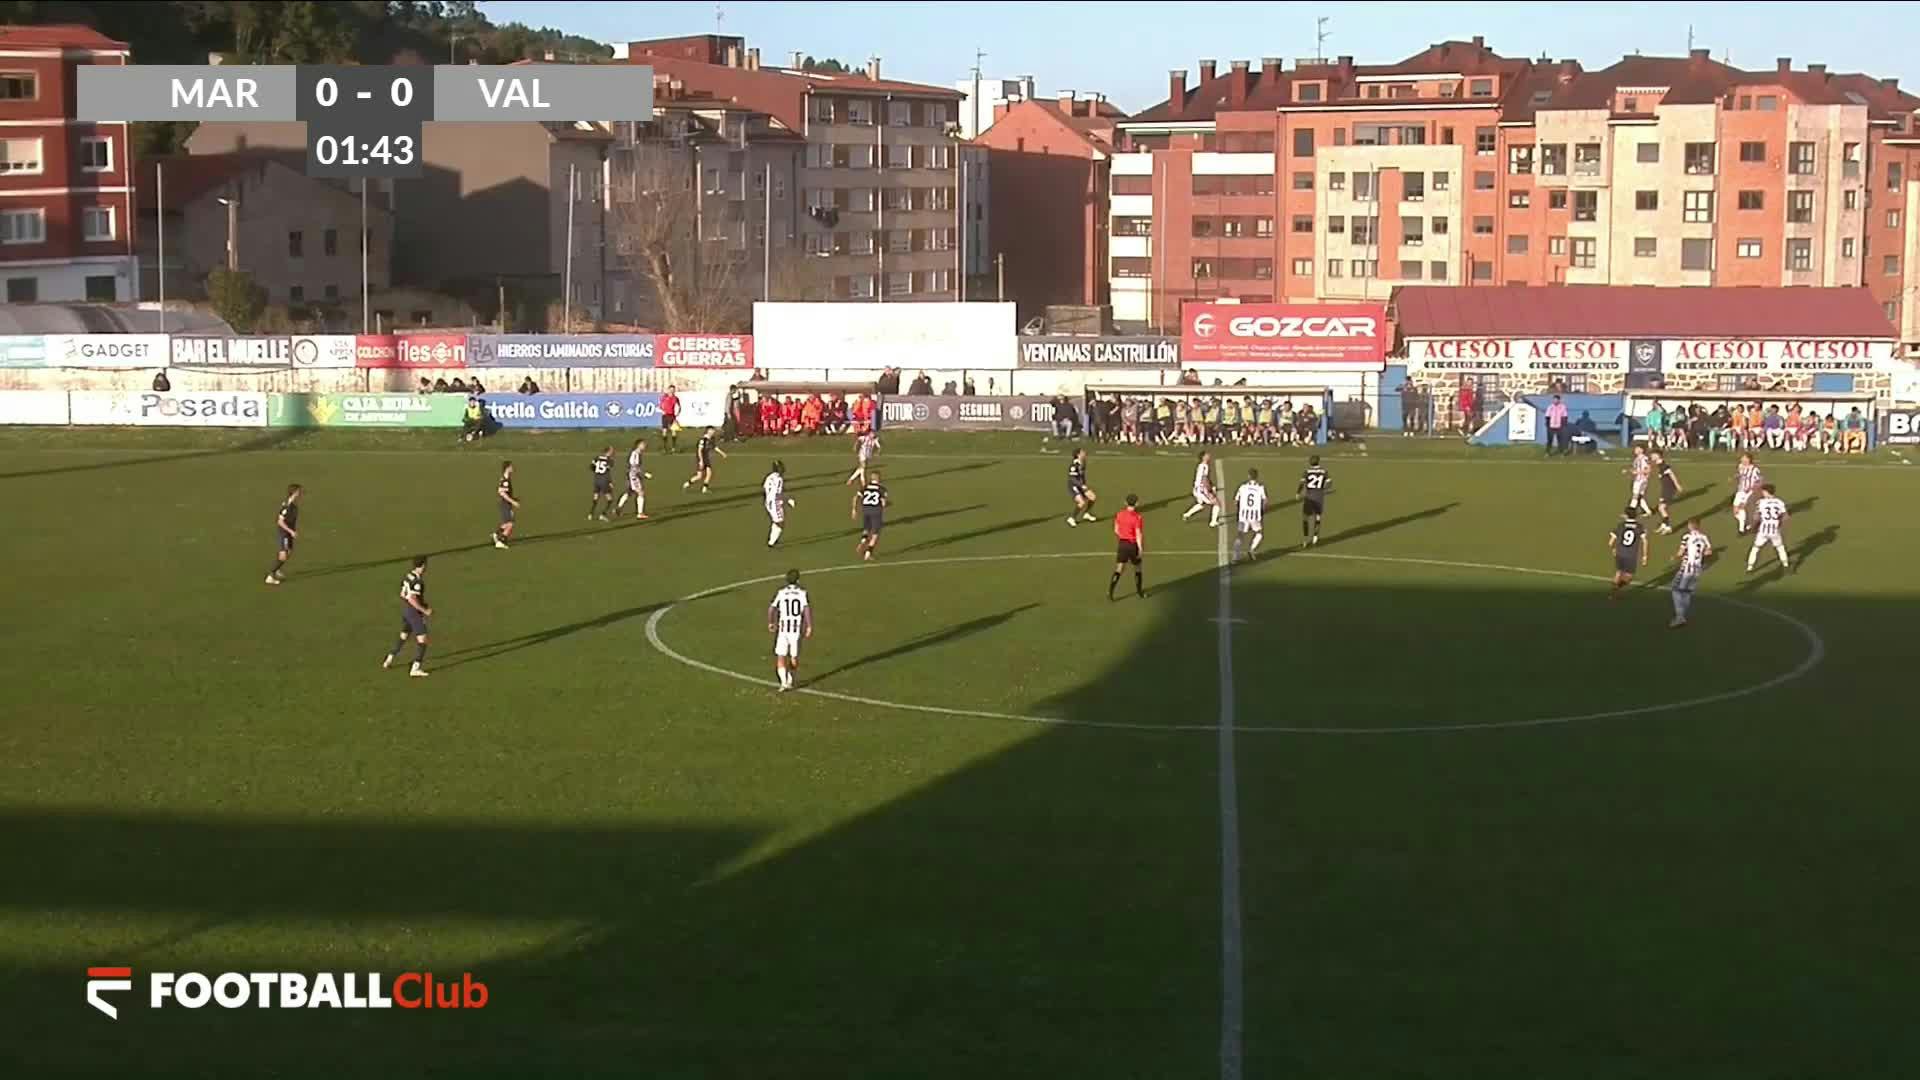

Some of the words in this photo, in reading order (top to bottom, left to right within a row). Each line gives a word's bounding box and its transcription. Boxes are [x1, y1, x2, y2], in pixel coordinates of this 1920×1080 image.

[1229, 316, 1377, 337] GOZCAR
[81, 343, 149, 358] GADGET
[172, 339, 206, 363] BAR
[207, 339, 226, 363] EL
[228, 339, 290, 363] MUELLE
[497, 343, 542, 358] HIERROS
[543, 343, 603, 359] LAMINADOS
[604, 344, 653, 359] ASTURIAS
[667, 337, 742, 352] CIERRES
[1022, 343, 1091, 363] VENTANAS
[1093, 339, 1178, 363] CASTRILLÓN
[1424, 339, 1515, 360] ACESOL
[1528, 339, 1621, 360] ACESOL
[1675, 339, 1769, 360] ACESOL
[1780, 339, 1873, 360] ACESOL
[663, 351, 746, 367] GUERRAS
[141, 393, 260, 418] Posada
[540, 401, 599, 419] Galicia
[960, 403, 1002, 417] SEGUNDA
[594, 460, 607, 474] 15
[862, 490, 880, 505] 23
[1247, 493, 1255, 507] 6
[1764, 507, 1779, 521] 33
[1622, 530, 1635, 546] 9
[784, 598, 801, 617] 10
